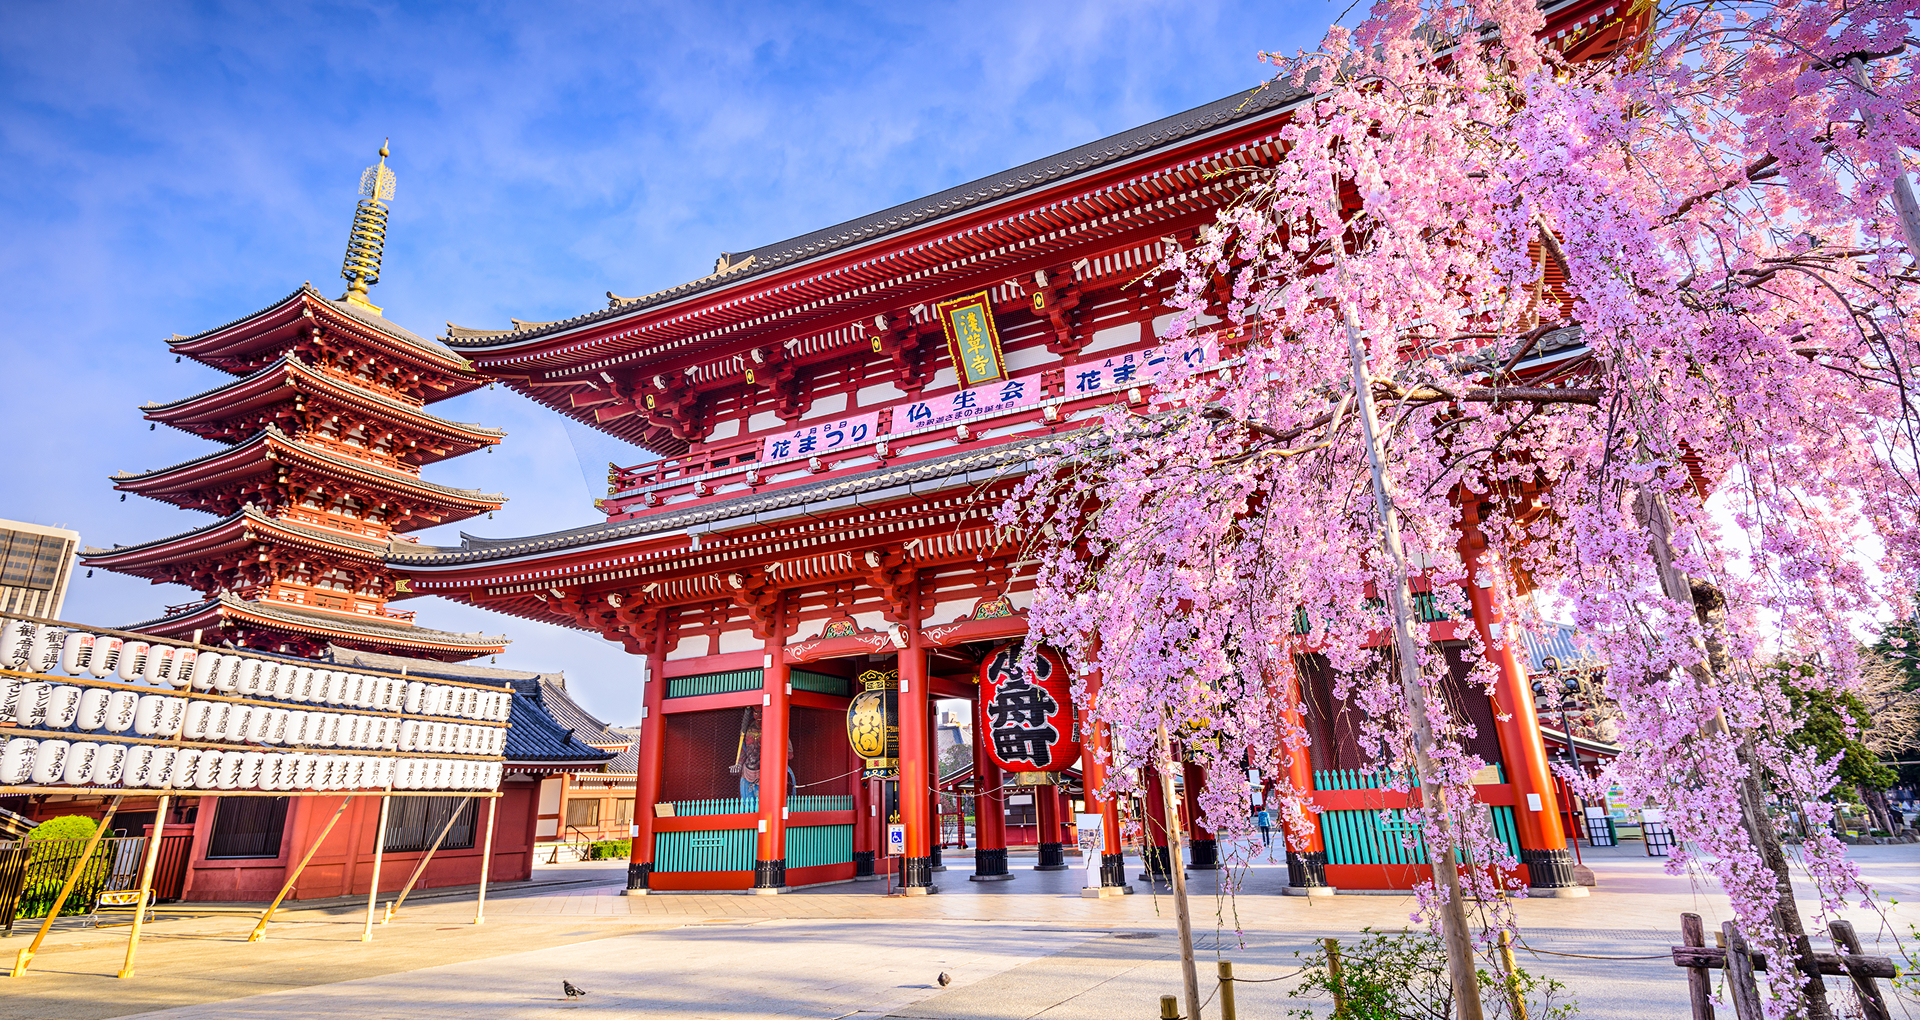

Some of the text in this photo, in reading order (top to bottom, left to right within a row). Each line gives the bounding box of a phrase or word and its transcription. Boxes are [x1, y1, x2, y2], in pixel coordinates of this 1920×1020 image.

[1104, 349, 1169, 368] 4月8
[906, 381, 1026, 423] 仏生会
[915, 400, 1015, 428] お釈迦さまのお誕生日
[770, 423, 868, 460] 花まつり
[794, 421, 848, 439] 4月8日
[12, 624, 37, 666] 観音通り
[42, 630, 65, 670] 観音通り
[0, 681, 22, 723] オレンジ通り
[30, 684, 51, 724] オレンジ通り
[61, 690, 79, 722] 浅草今半
[94, 694, 109, 725] 浅草今半
[118, 695, 134, 726] 浅草今半
[150, 699, 164, 728] 浅草今半
[168, 702, 183, 730] 浅草今半
[987, 643, 1059, 767] 小舟町
[48, 746, 66, 778] 浅草今半
[78, 747, 95, 779] 浅草今半
[106, 748, 124, 780] 浅草今半
[136, 749, 153, 781] 浅草今半
[158, 751, 175, 782] 浅草今半
[183, 755, 202, 783] 米久
[207, 756, 223, 783] 米久
[229, 758, 244, 785] 米久
[250, 758, 264, 784] 米久
[271, 758, 283, 784] 米久
[286, 759, 300, 785] 米久
[304, 759, 318, 784] 米久
[322, 761, 334, 785] 米久
[336, 761, 350, 785] 米久
[352, 761, 365, 785] 米久
